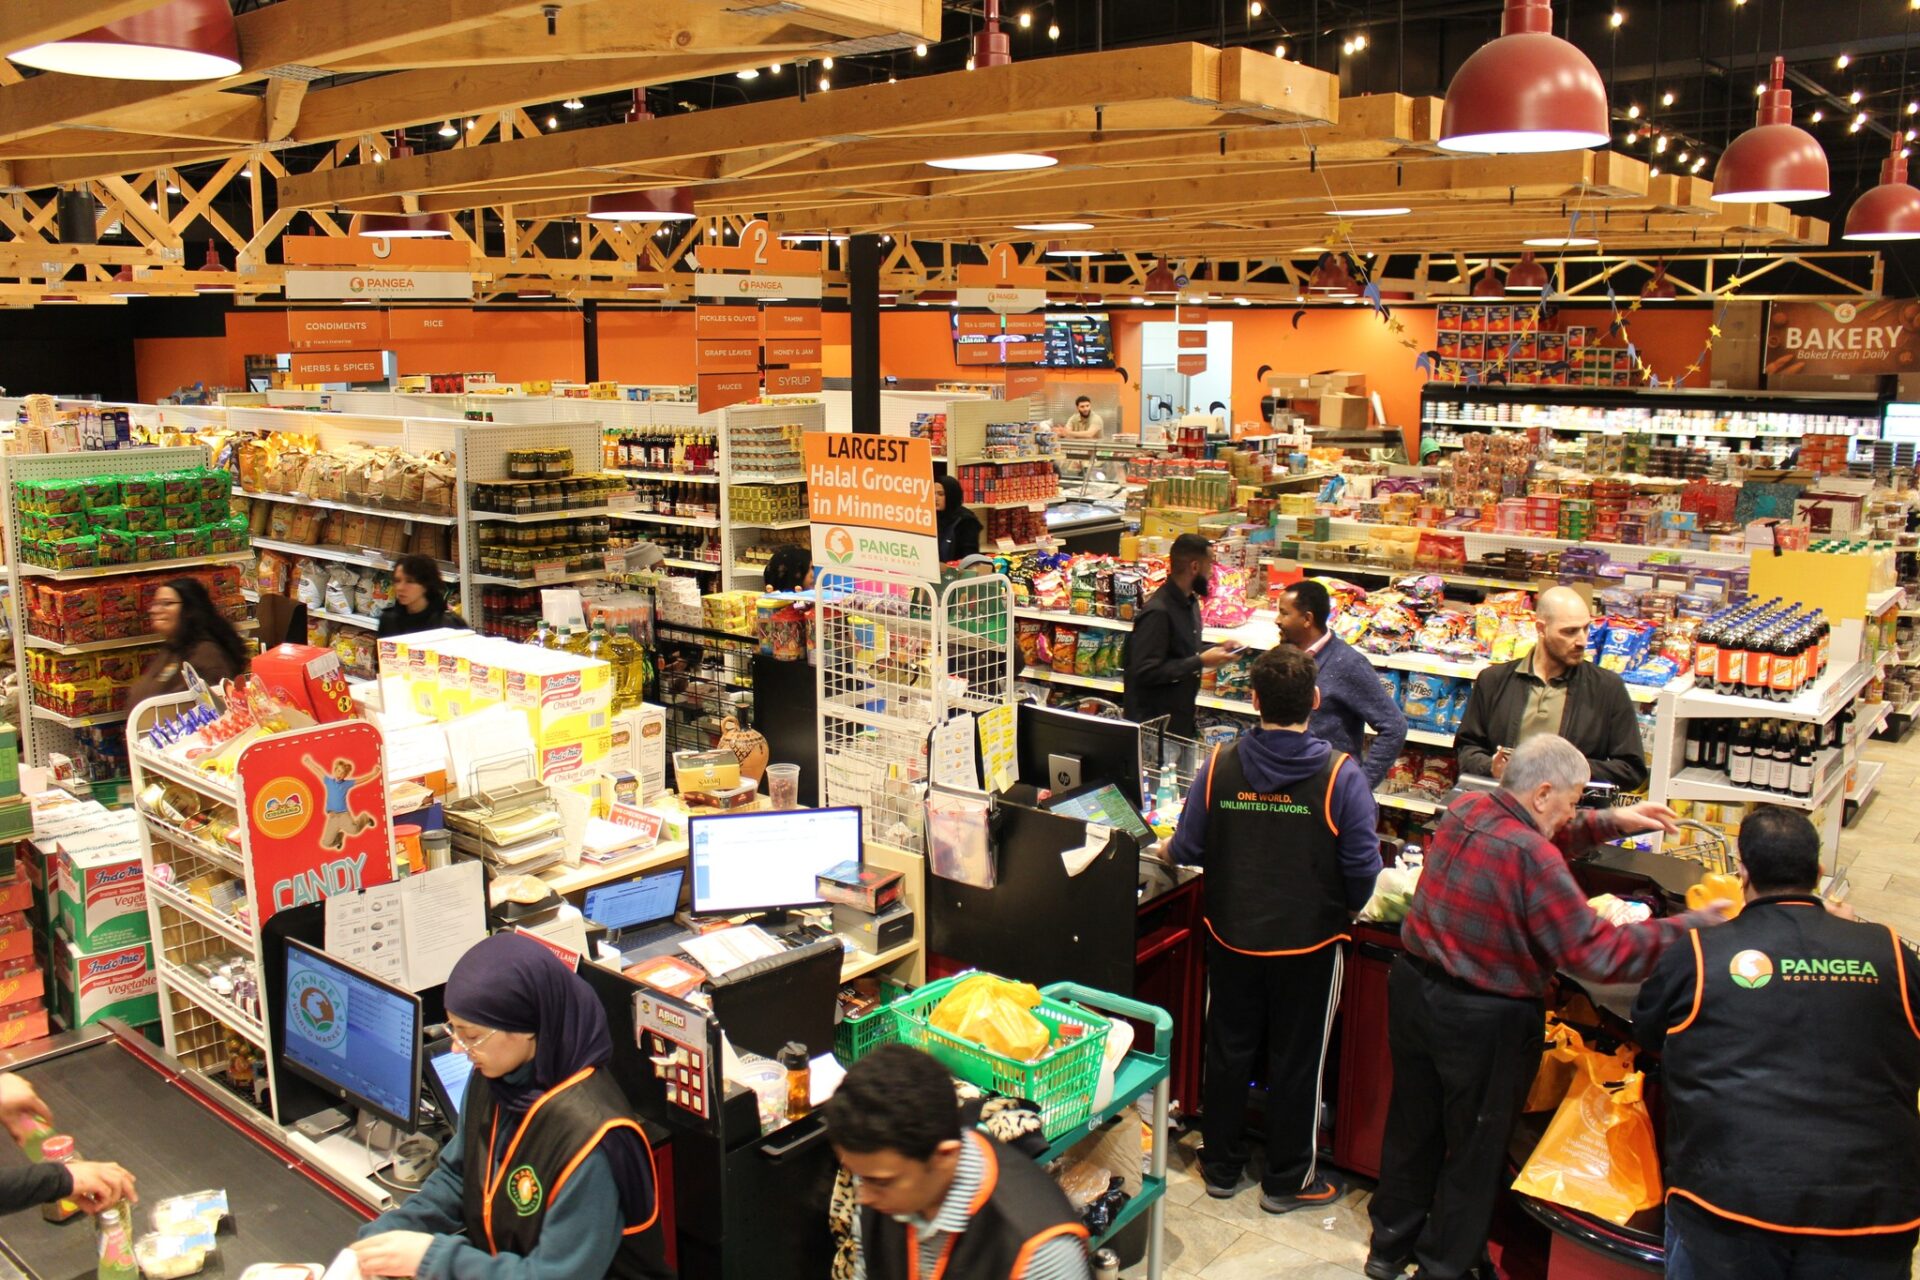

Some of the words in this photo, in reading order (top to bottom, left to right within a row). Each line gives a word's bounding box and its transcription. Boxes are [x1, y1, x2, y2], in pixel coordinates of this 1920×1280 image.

[754, 228, 768, 264] 2
[999, 249, 1007, 279] 1
[367, 278, 414, 288] PANGEA
[751, 280, 783, 290] PANGEA
[305, 322, 367, 331] CONDIMENTS
[423, 320, 444, 328] RICE
[1786, 326, 1903, 350] BAKERY
[1797, 349, 1829, 360] Baked
[1831, 349, 1860, 360] Fresh
[1862, 349, 1890, 361] Daily
[300, 364, 331, 373] HERBS
[343, 363, 375, 372] SPICES
[717, 383, 743, 391] SAUCES
[778, 375, 811, 387] SYRUP
[828, 436, 909, 463] LARGEST
[811, 464, 858, 488] Halal
[862, 467, 931, 503] Grocery
[813, 492, 832, 515] in
[837, 494, 932, 527] Minnesota
[859, 538, 920, 560] PANGEA
[553, 698, 578, 711] Chicken
[580, 696, 596, 708] Curry
[554, 770, 579, 783] Chicken
[580, 768, 596, 780] Curry
[1237, 791, 1257, 801] ONE
[1259, 793, 1292, 803] WORLD.
[1220, 800, 1268, 811] UNLIMITED
[1269, 803, 1312, 815] FLAVORS.
[615, 815, 651, 832] CLOSED
[272, 852, 367, 913] CANDY
[1780, 958, 1878, 977] PANGEA
[107, 976, 157, 995] Vegetable
[1830, 975, 1880, 985] MARKET
[294, 974, 341, 1009] PANGEA
[292, 1002, 314, 1038] WORLD
[314, 1023, 343, 1044] MARKET
